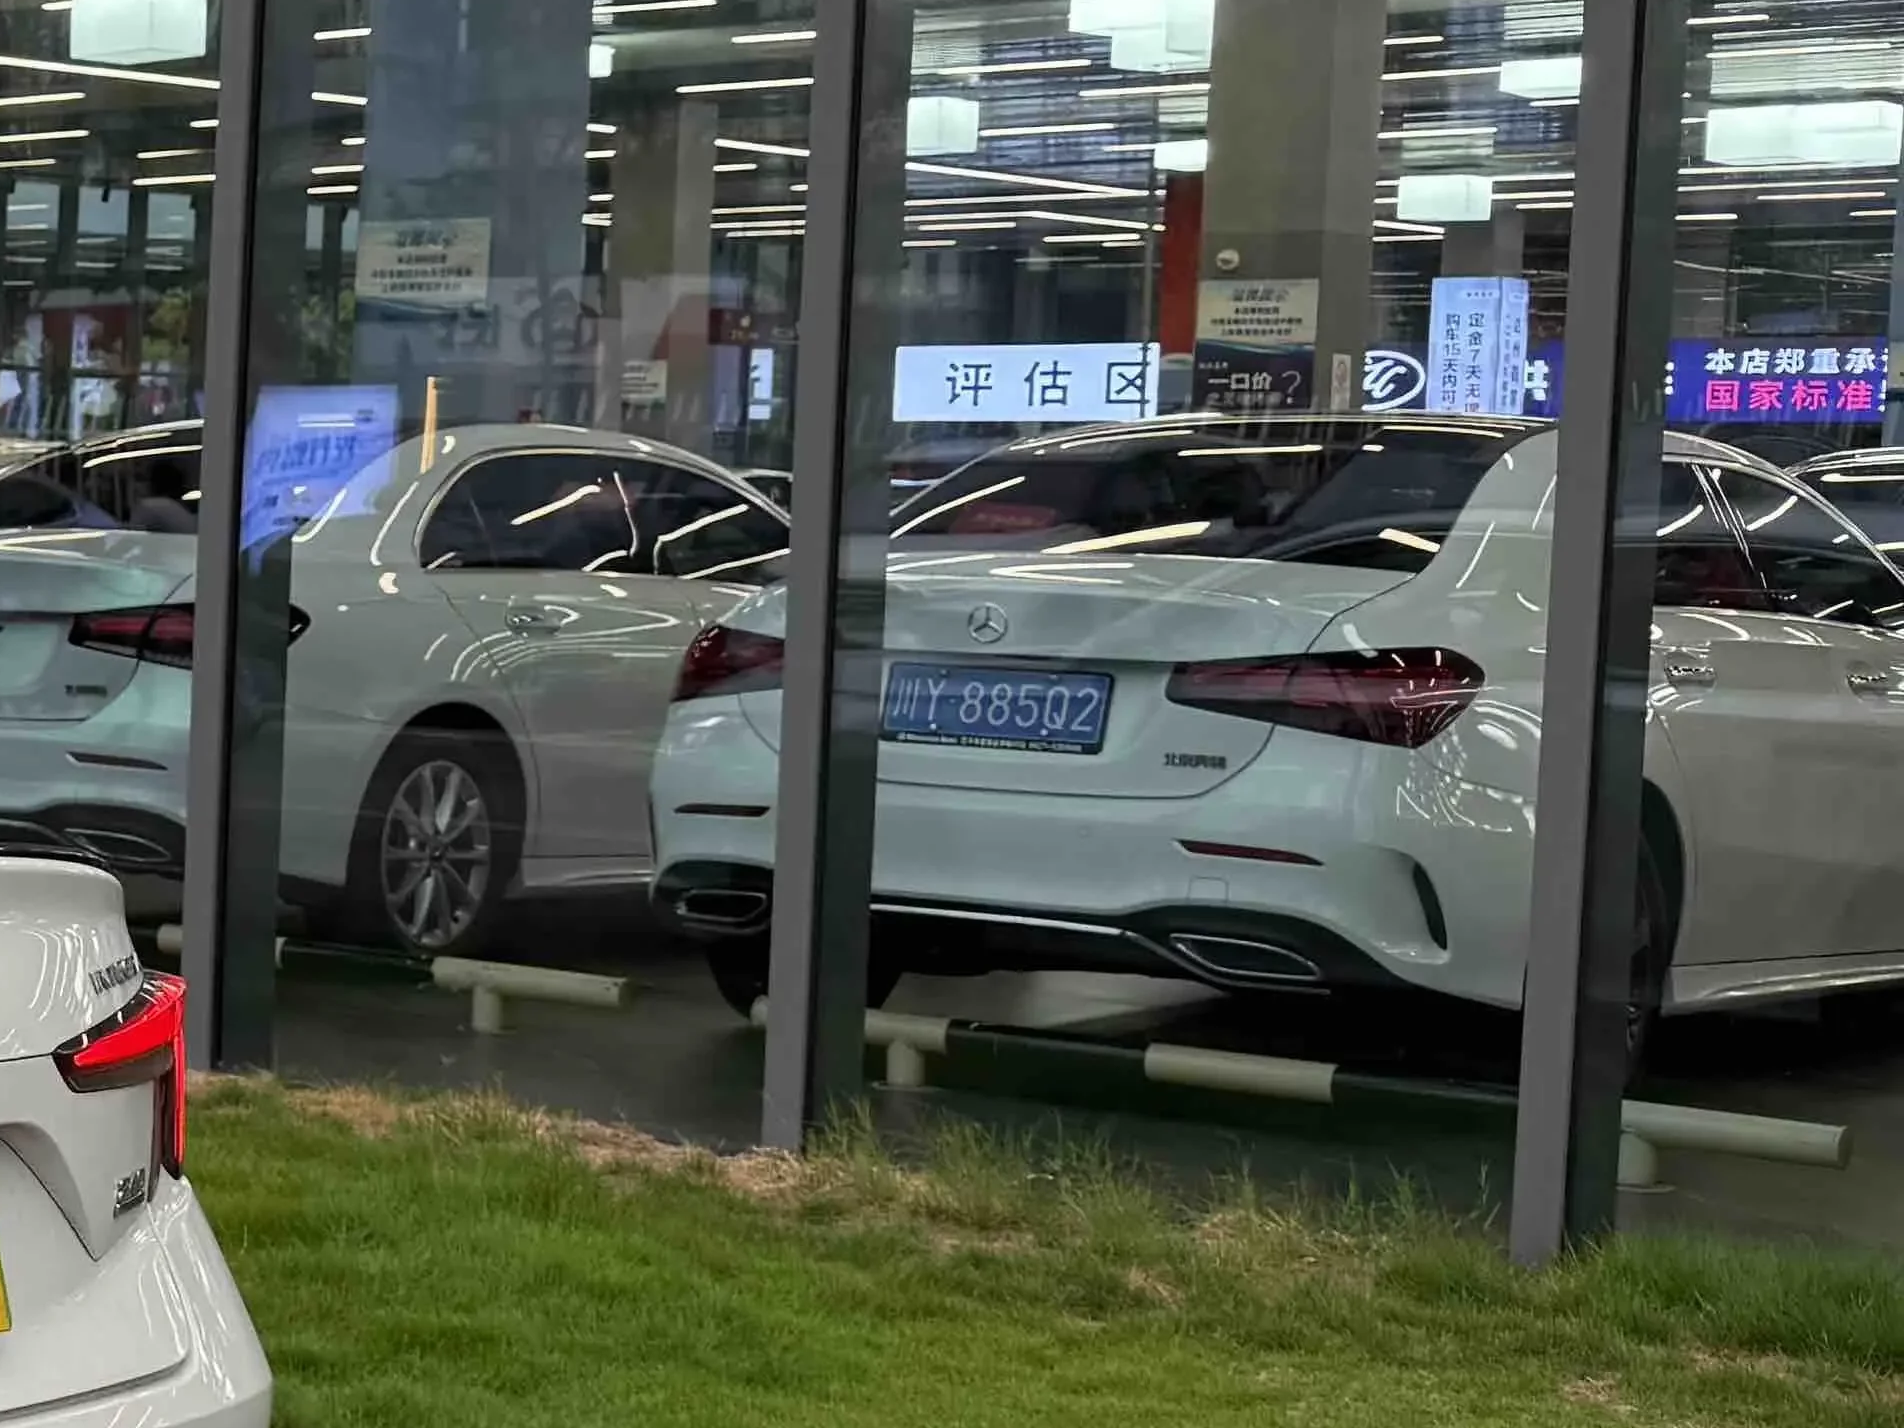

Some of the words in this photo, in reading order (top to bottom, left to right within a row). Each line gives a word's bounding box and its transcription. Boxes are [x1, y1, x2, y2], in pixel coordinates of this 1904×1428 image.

[945, 361, 1150, 408] 评估区
[1208, 371, 1273, 390] 一口价
[1441, 313, 1462, 411] 购车15天内可
